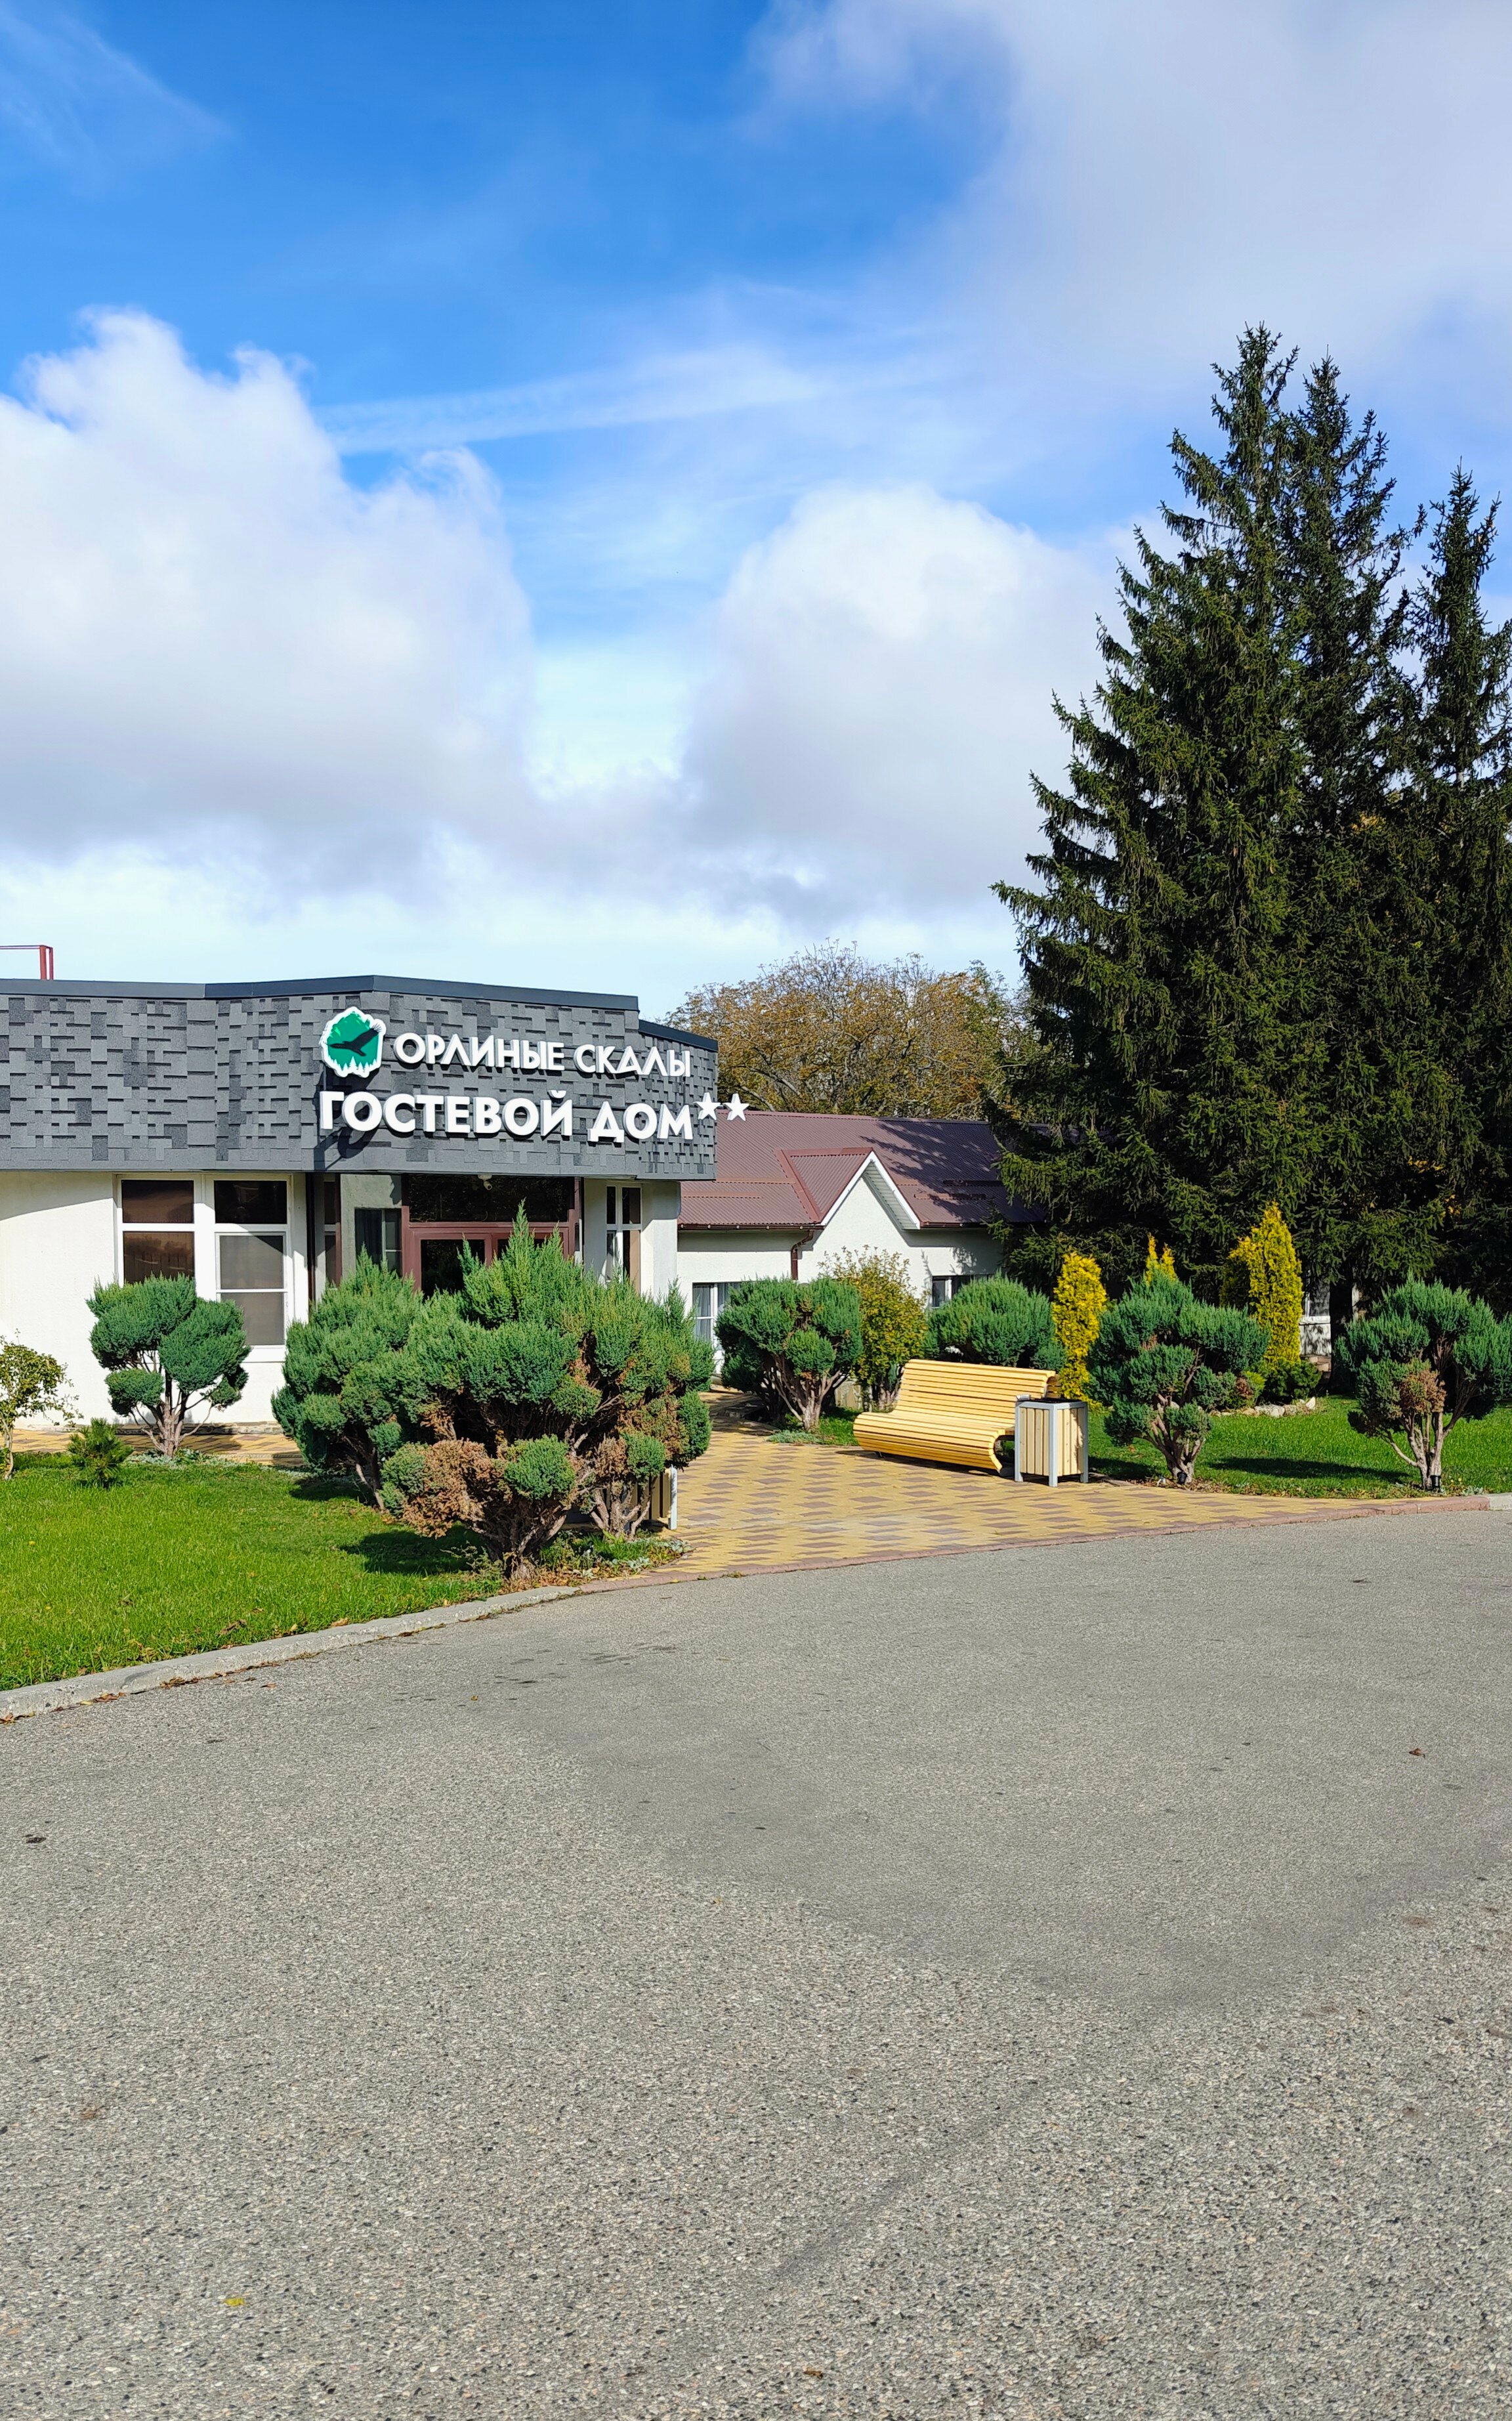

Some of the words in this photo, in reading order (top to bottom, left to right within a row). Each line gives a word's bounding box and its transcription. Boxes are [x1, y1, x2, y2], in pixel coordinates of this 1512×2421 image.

[394, 1033, 564, 1071] ОРЛИНЫЕ
[574, 1044, 691, 1078] СКАЛЫ
[320, 1090, 573, 1137] ГОСТЕВОЙ
[588, 1100, 694, 1143] ДОМ
